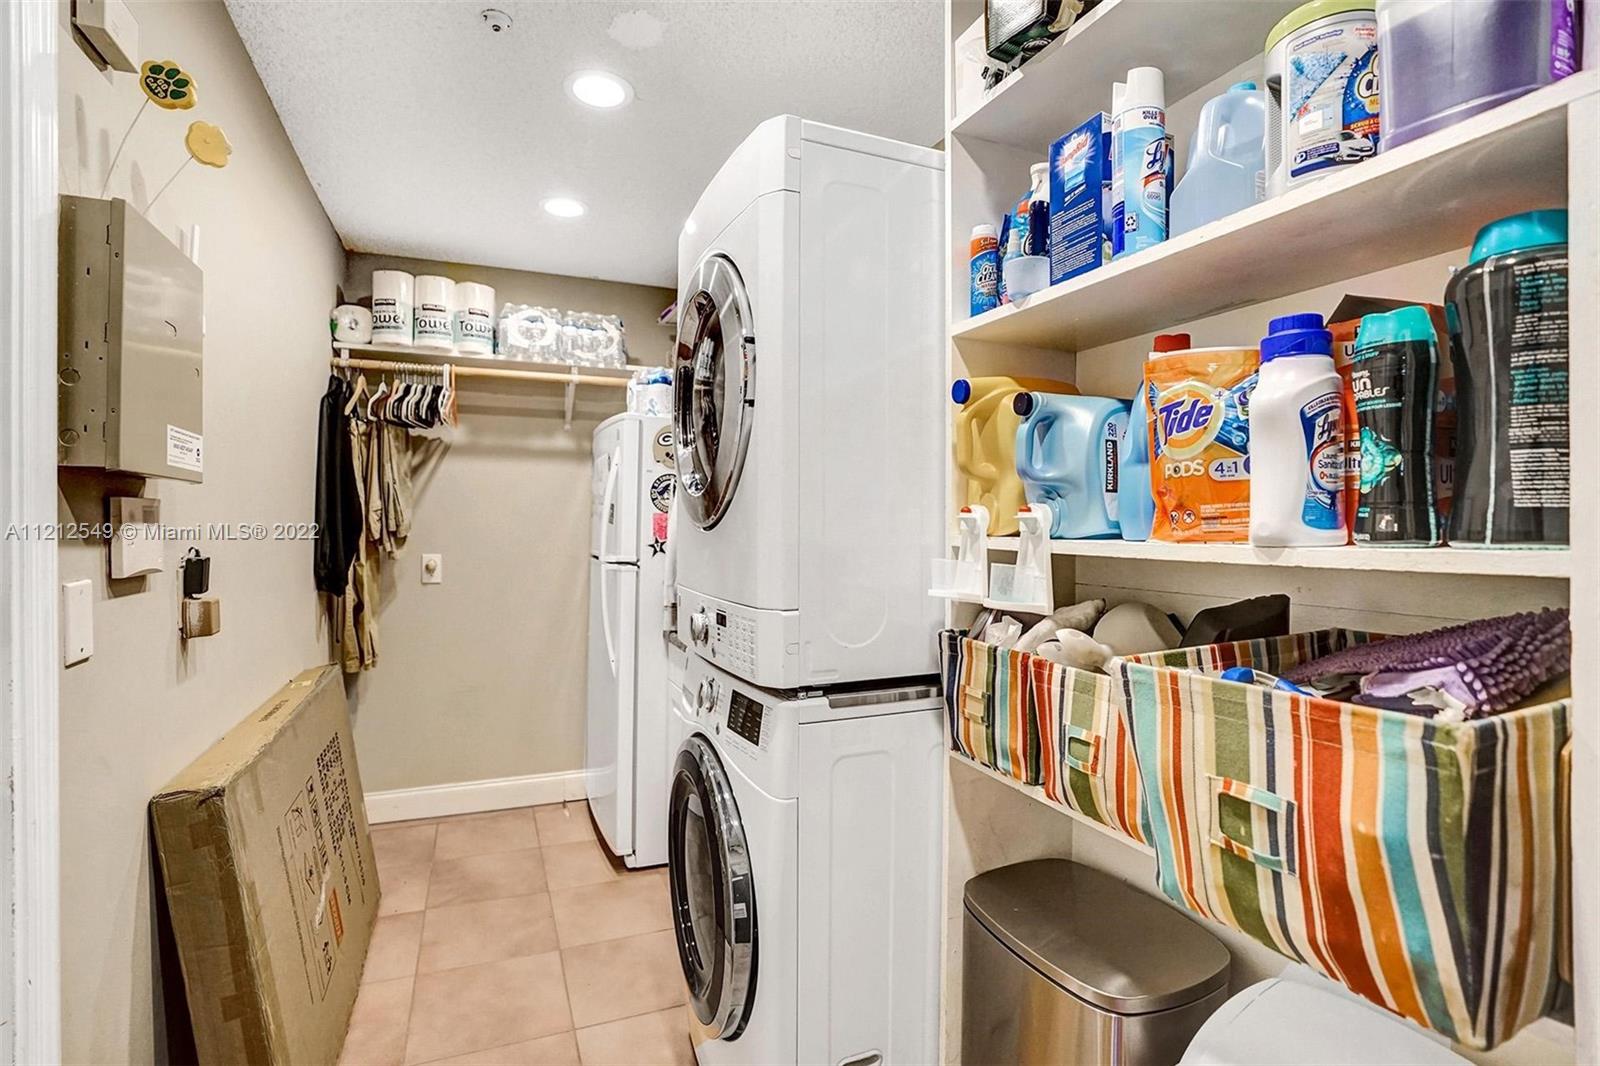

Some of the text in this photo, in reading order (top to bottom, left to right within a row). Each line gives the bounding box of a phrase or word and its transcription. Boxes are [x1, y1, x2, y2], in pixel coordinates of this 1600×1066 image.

[146, 78, 166, 97] CATS
[157, 79, 169, 90] GO
[1158, 399, 1214, 446] Tide
[1106, 441, 1114, 491] KIRKLAND
[1165, 459, 1205, 479] PODS
